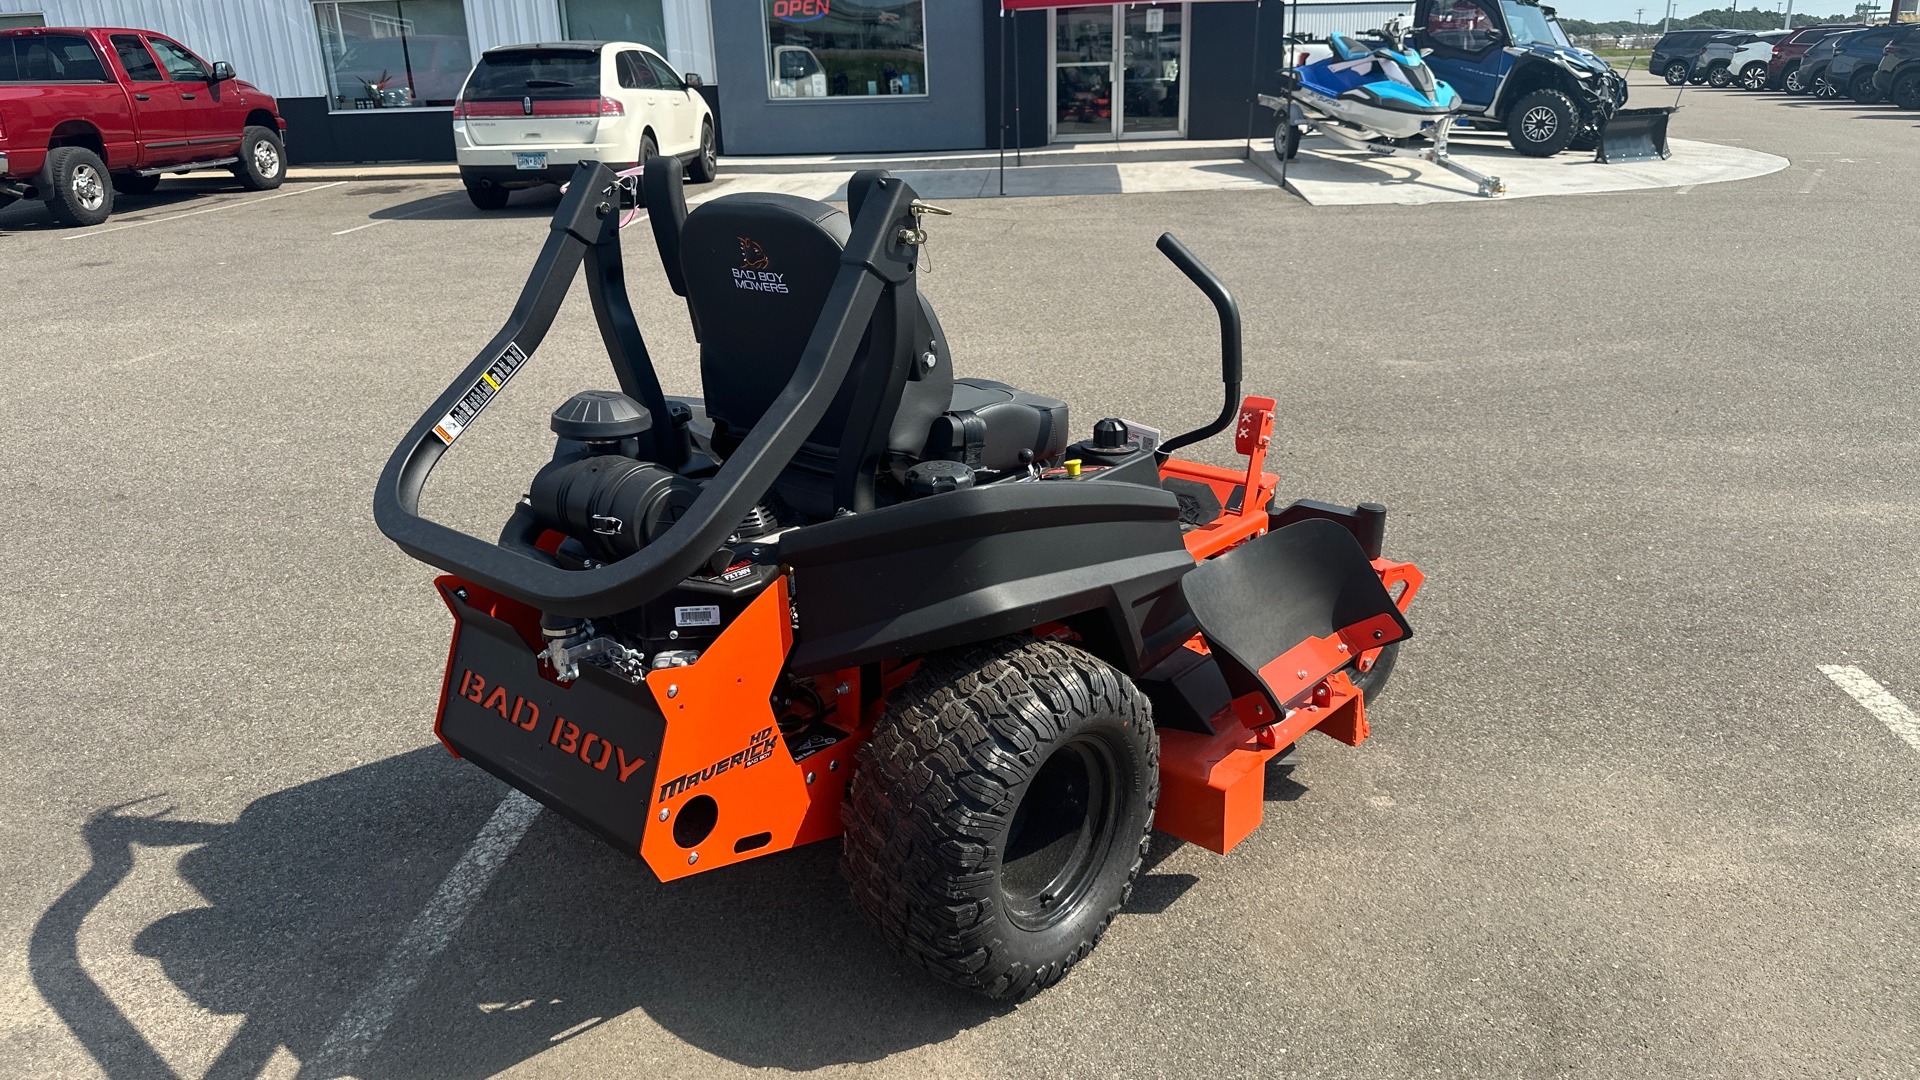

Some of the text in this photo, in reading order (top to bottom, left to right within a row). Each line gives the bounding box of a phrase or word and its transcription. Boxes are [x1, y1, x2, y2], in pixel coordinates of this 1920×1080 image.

[773, 0, 830, 17] OPEN
[731, 268, 784, 283] BAD BOY
[734, 278, 789, 294] MOWERS
[458, 668, 647, 784] BAD BOY
[749, 726, 773, 746] HD
[746, 751, 771, 767] BAD BOY
[658, 734, 778, 803] MAVERICK
